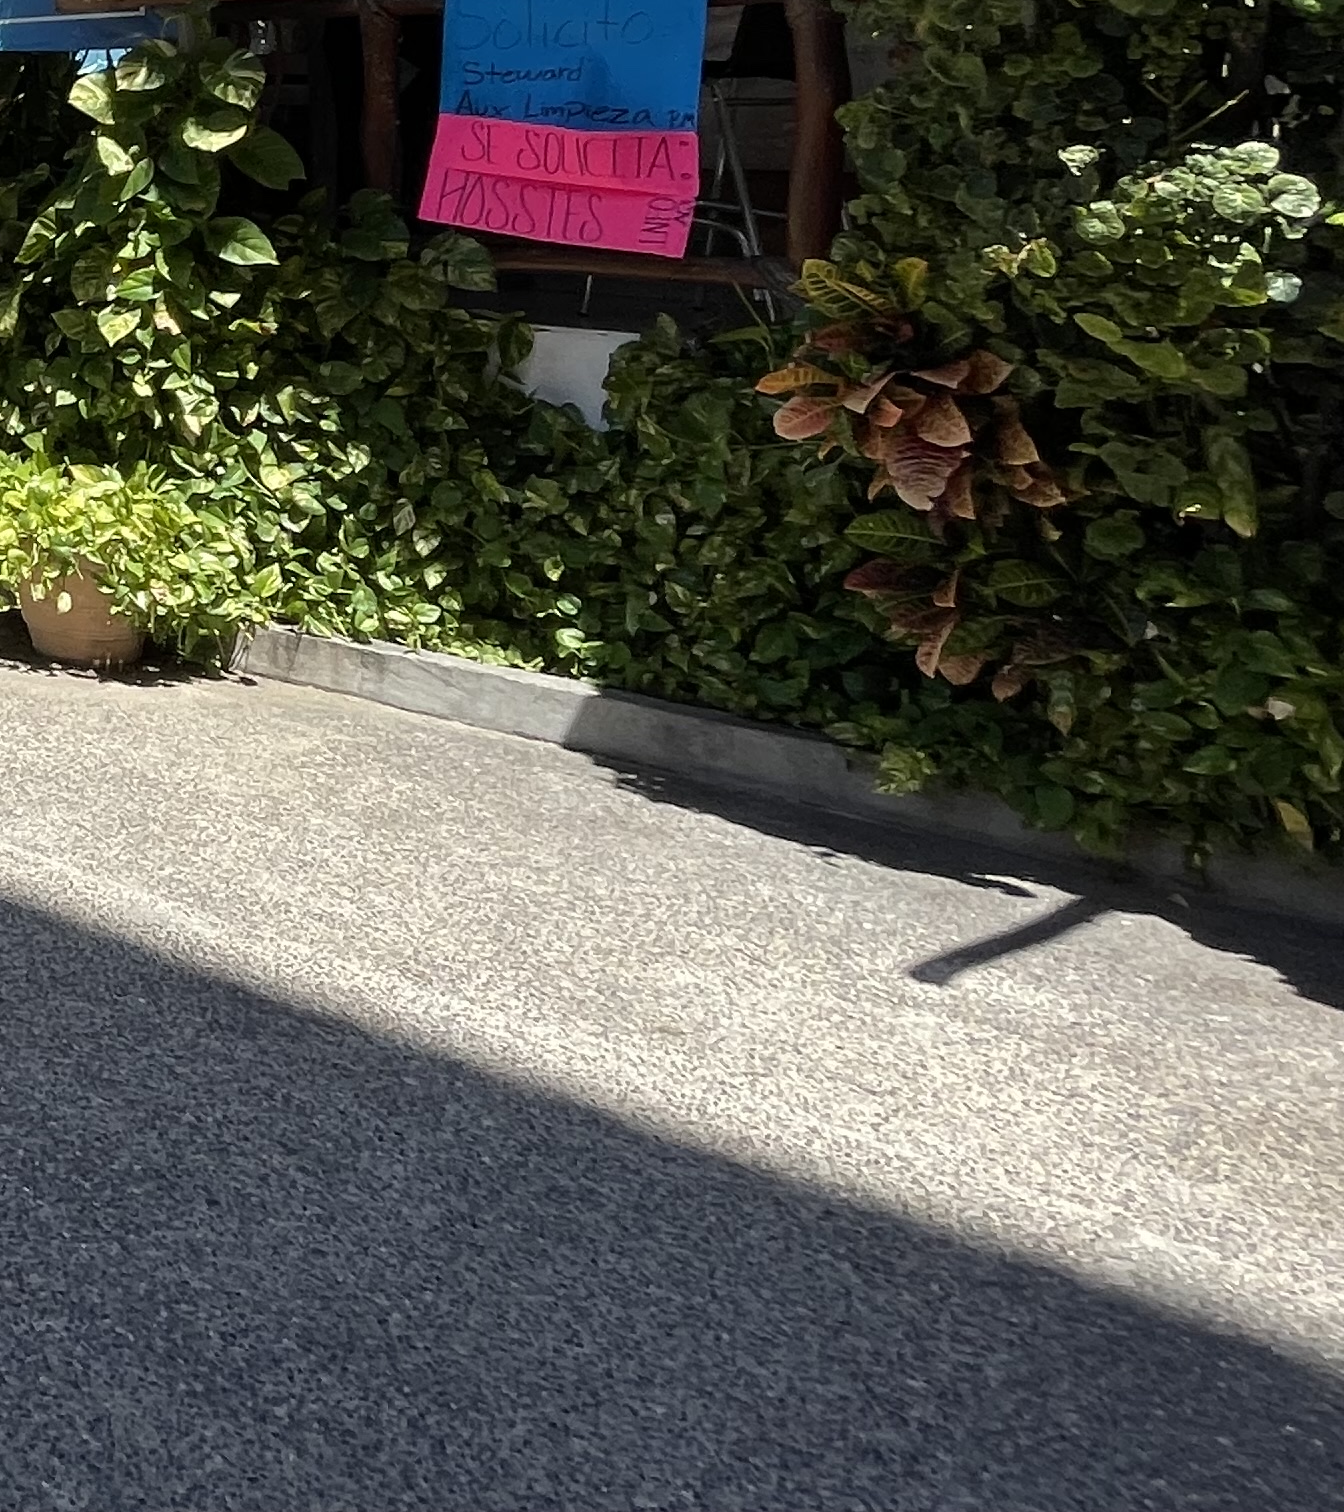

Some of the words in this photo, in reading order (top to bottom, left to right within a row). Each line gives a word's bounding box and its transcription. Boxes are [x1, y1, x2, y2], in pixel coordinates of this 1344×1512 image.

[463, 57, 584, 85] Steward
[462, 121, 498, 164] SE
[436, 167, 604, 242] HOSSTES
